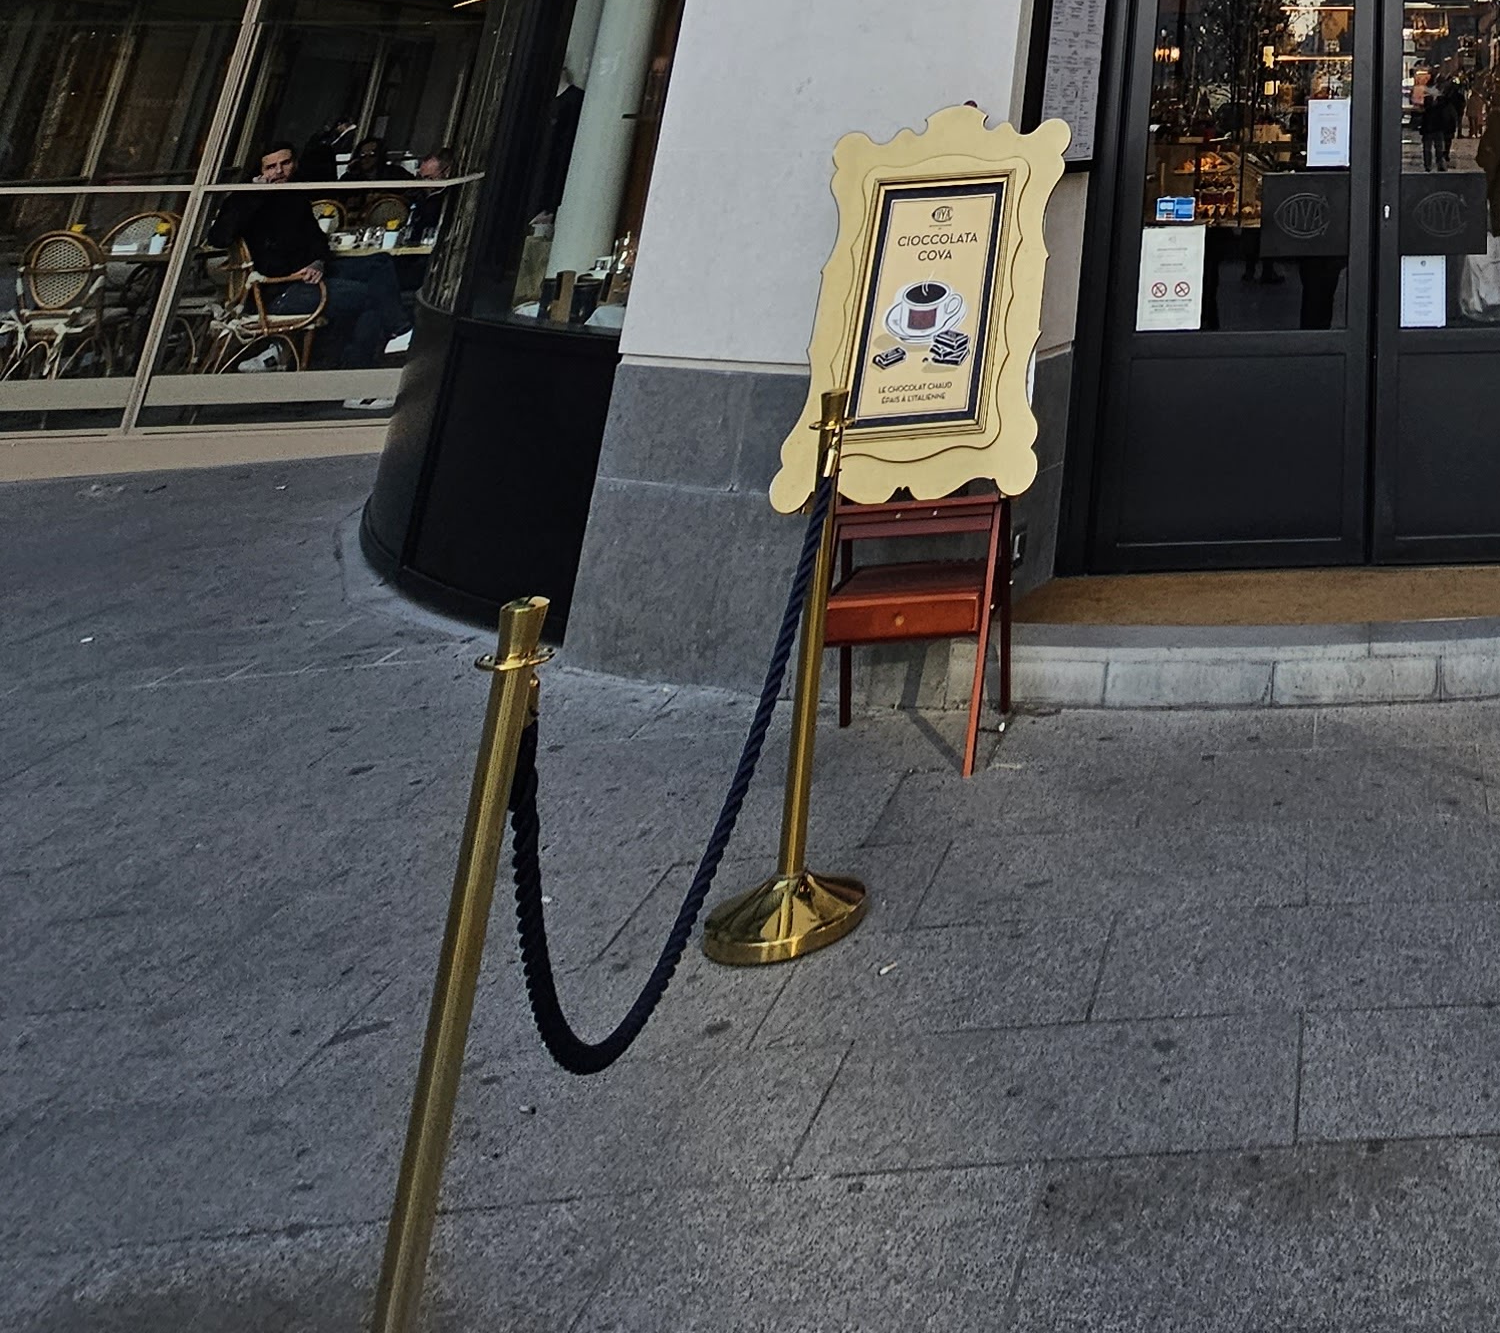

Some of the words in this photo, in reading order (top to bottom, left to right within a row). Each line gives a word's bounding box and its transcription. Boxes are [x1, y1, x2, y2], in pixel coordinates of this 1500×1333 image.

[897, 231, 978, 247] CIOCCOLATA
[917, 249, 953, 262] COVA
[878, 386, 886, 395] LE
[887, 383, 926, 394] CHOCOLAT
[927, 381, 953, 391] CHAUD
